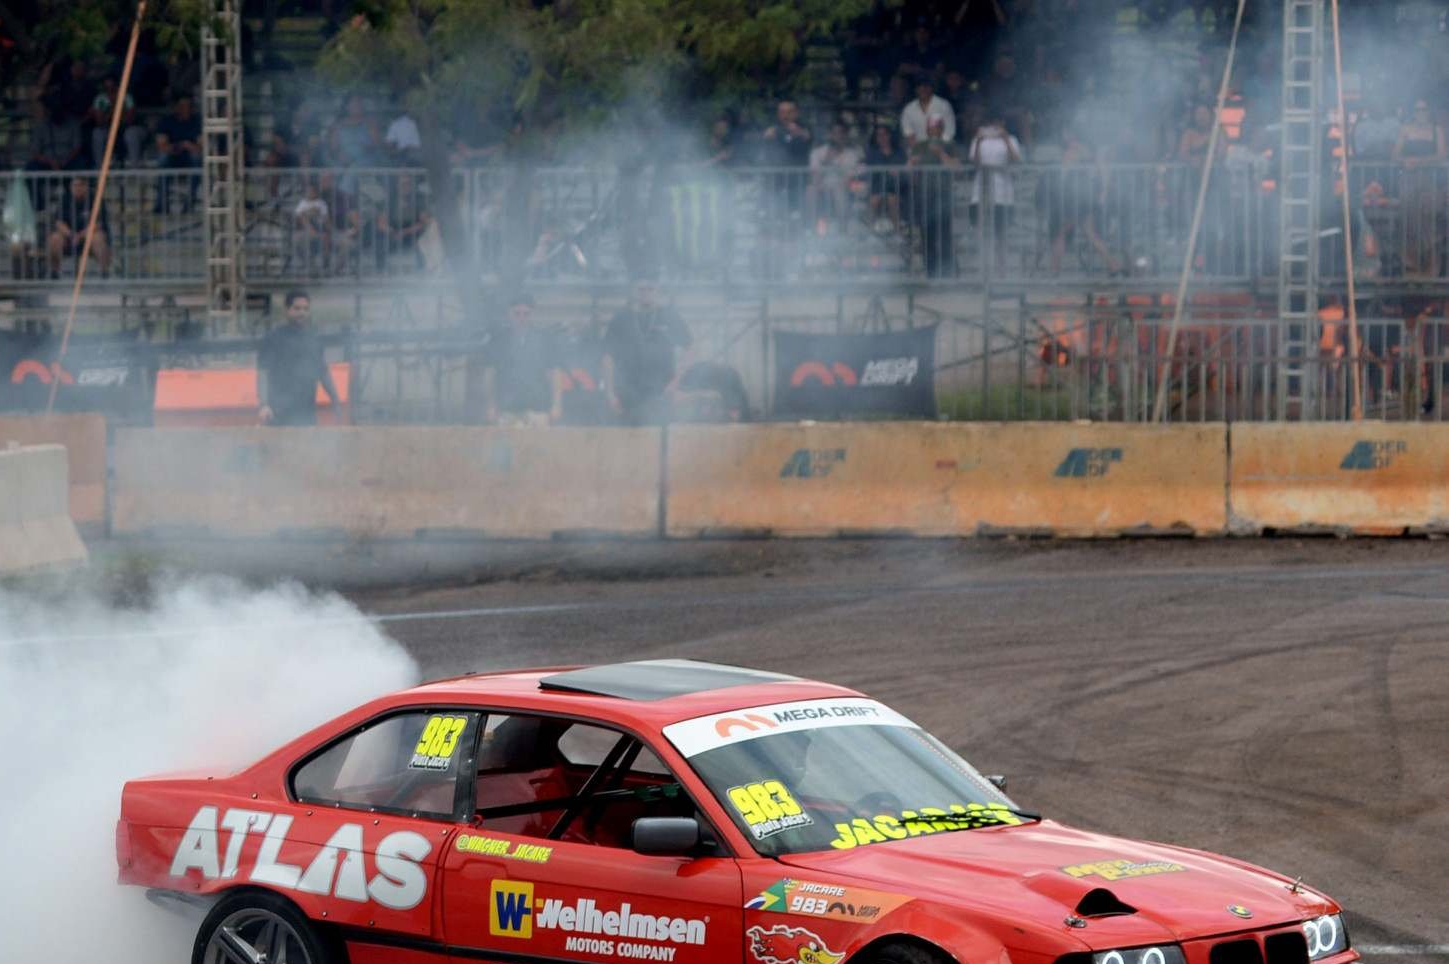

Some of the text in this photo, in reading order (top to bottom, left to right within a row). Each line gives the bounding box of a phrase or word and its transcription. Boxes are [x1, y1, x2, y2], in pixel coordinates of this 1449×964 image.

[774, 705, 880, 724] MEGA DRIFT
[415, 715, 468, 758] 983
[727, 780, 804, 826] 983
[168, 805, 433, 911] ATLAS
[790, 895, 829, 915] 983
[565, 936, 676, 962] MOTORS COMPANY
